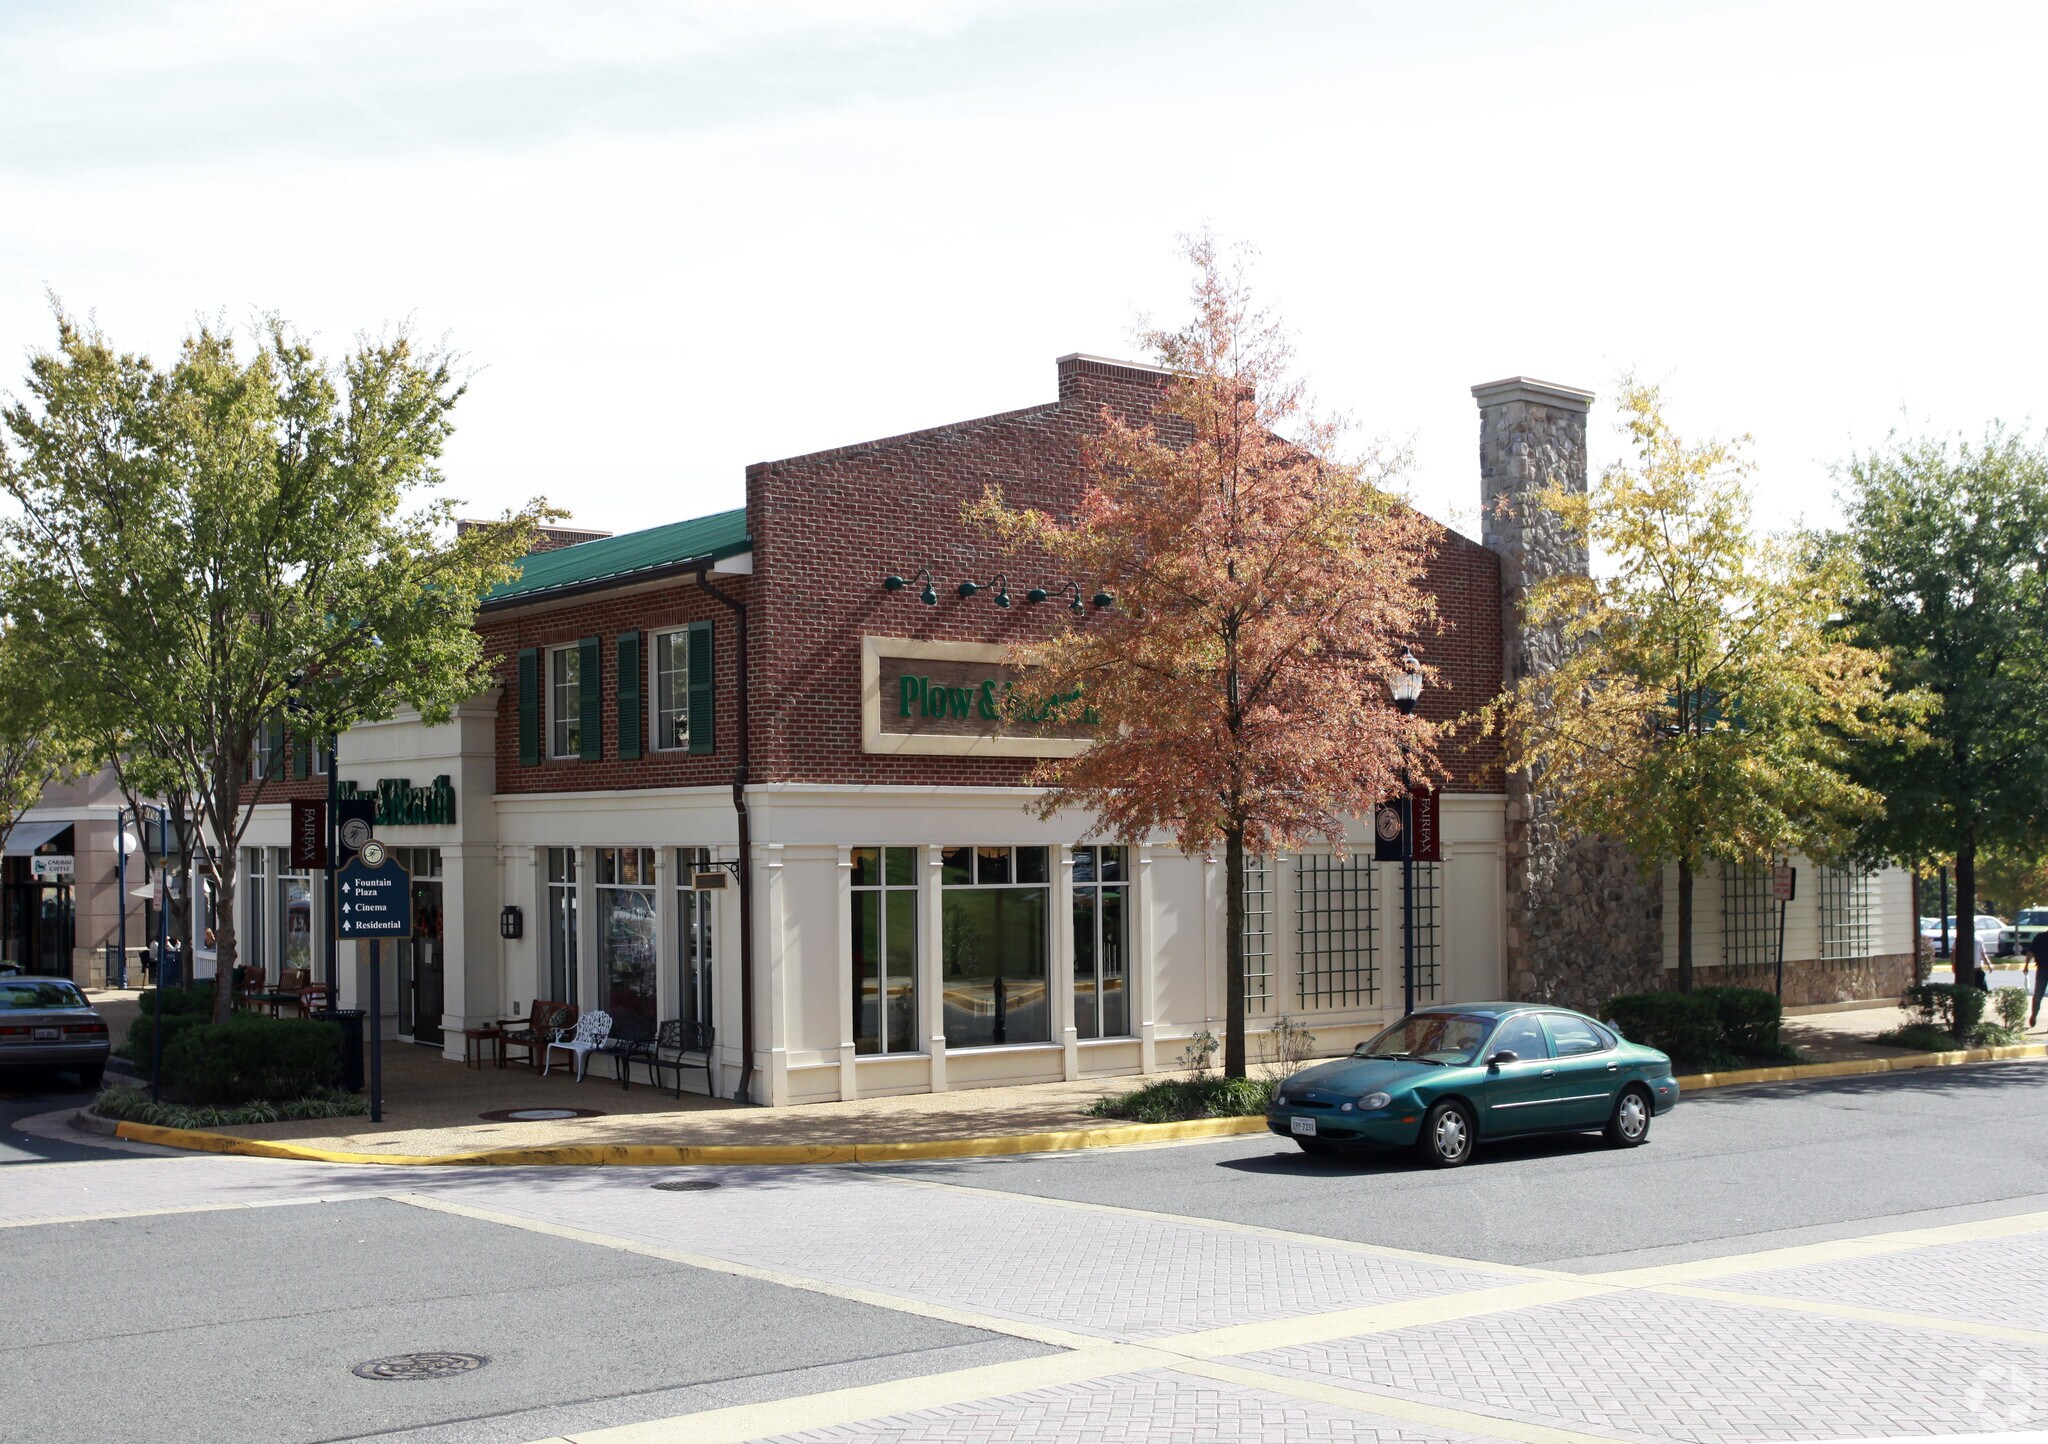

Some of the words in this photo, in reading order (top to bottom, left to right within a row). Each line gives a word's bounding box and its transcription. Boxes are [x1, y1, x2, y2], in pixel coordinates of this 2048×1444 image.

[899, 675, 974, 720] Plow
[979, 679, 1002, 722] &
[304, 809, 316, 860] FAIRFAX
[1421, 798, 1432, 853] FAIRFAX
[355, 903, 387, 911] Cinema
[356, 920, 401, 929] Residential
